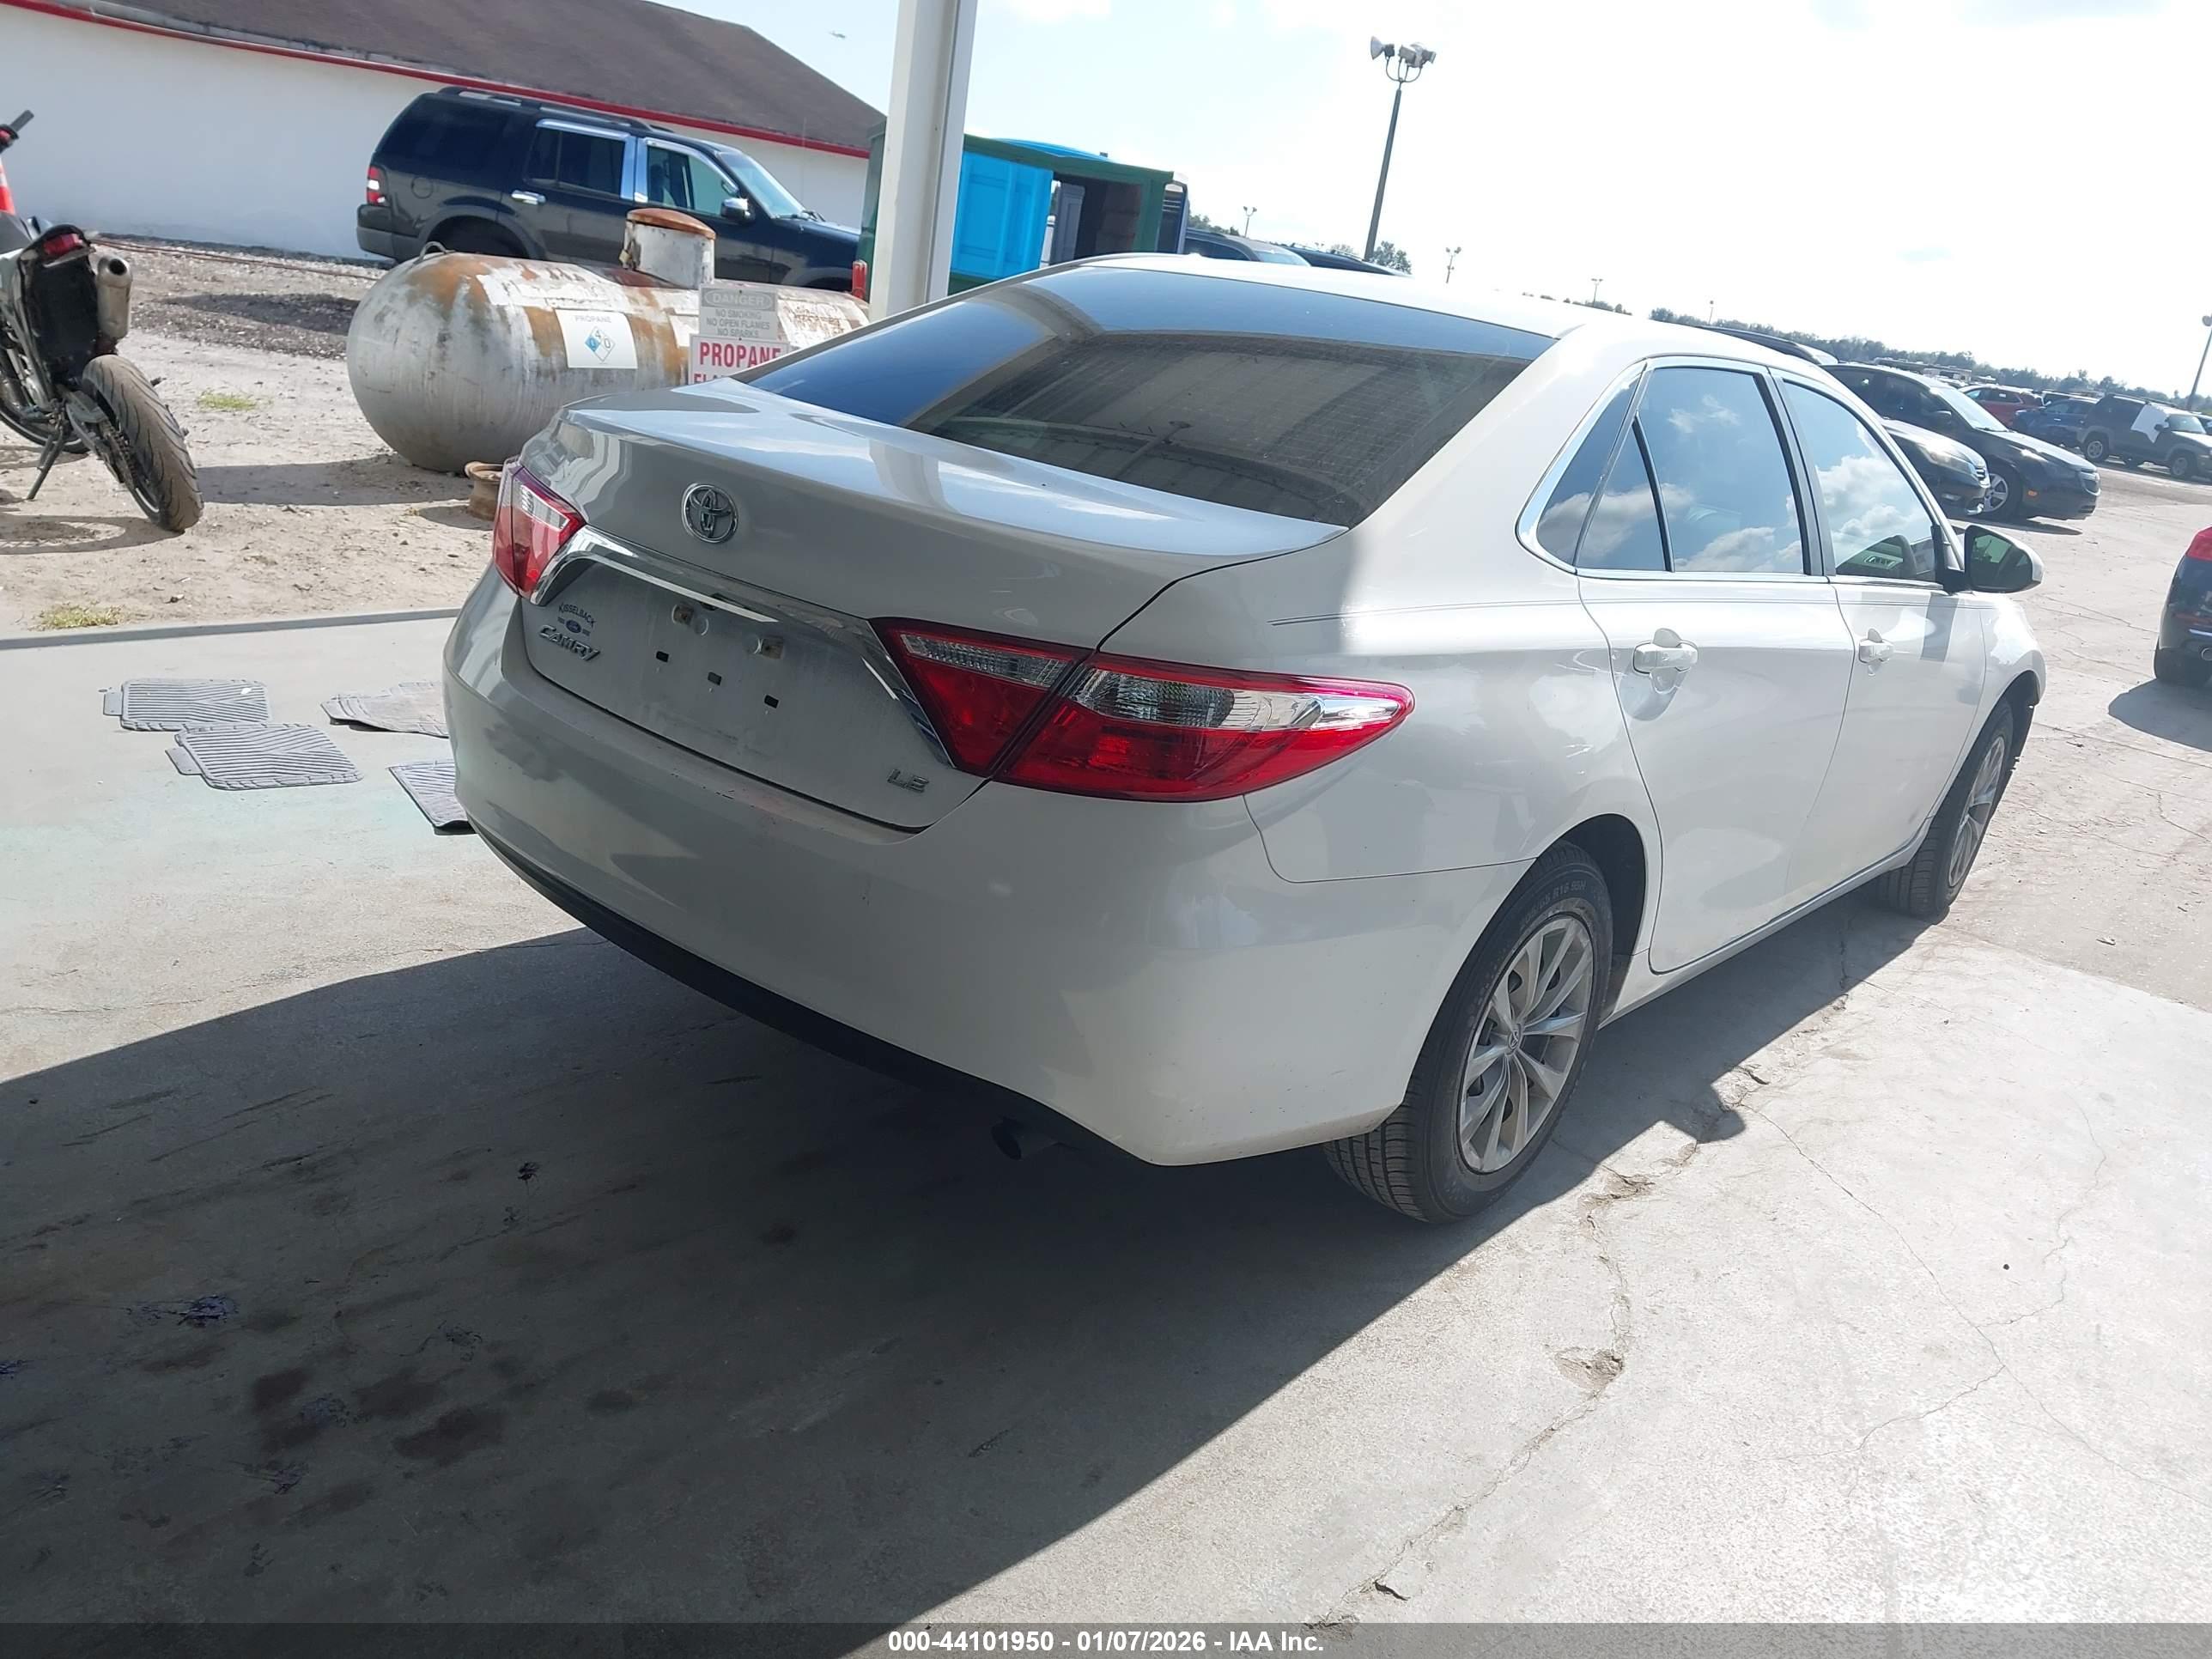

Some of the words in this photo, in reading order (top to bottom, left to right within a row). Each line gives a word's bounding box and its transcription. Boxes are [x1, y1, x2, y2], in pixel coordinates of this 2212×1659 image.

[712, 293, 765, 307] DANGER
[715, 309, 726, 318] NO
[728, 309, 762, 319] SMOKING
[707, 317, 718, 326] NO
[720, 318, 738, 327] OPEN
[741, 319, 770, 330] FLAMES
[717, 328, 729, 337] NO
[730, 328, 759, 337] SPARKS
[538, 624, 601, 661] CAMRY
[887, 769, 929, 793] LE
